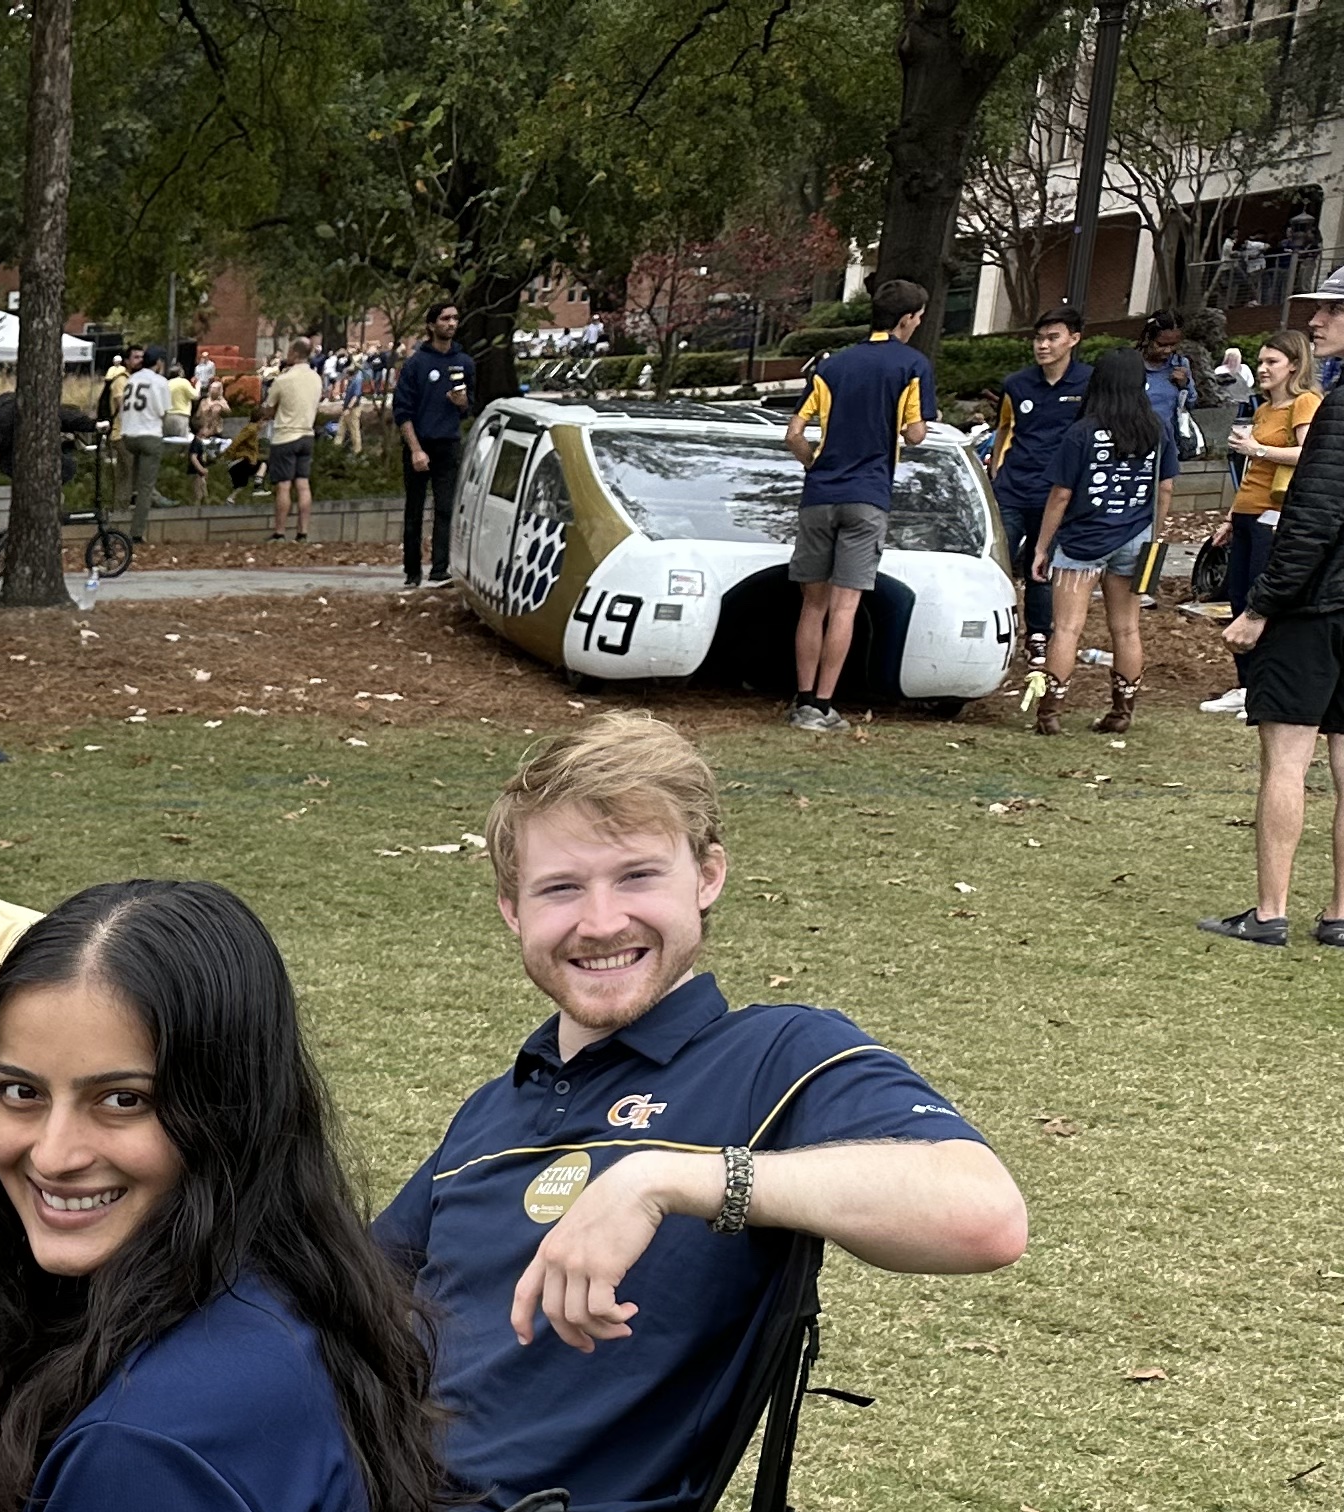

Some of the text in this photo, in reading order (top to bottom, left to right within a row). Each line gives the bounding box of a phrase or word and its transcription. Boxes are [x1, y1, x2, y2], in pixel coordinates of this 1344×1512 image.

[123, 383, 150, 411] 25
[573, 586, 644, 656] 49
[607, 1093, 668, 1129] GT
[538, 1166, 588, 1182] STING
[534, 1183, 574, 1196] MIAMI
